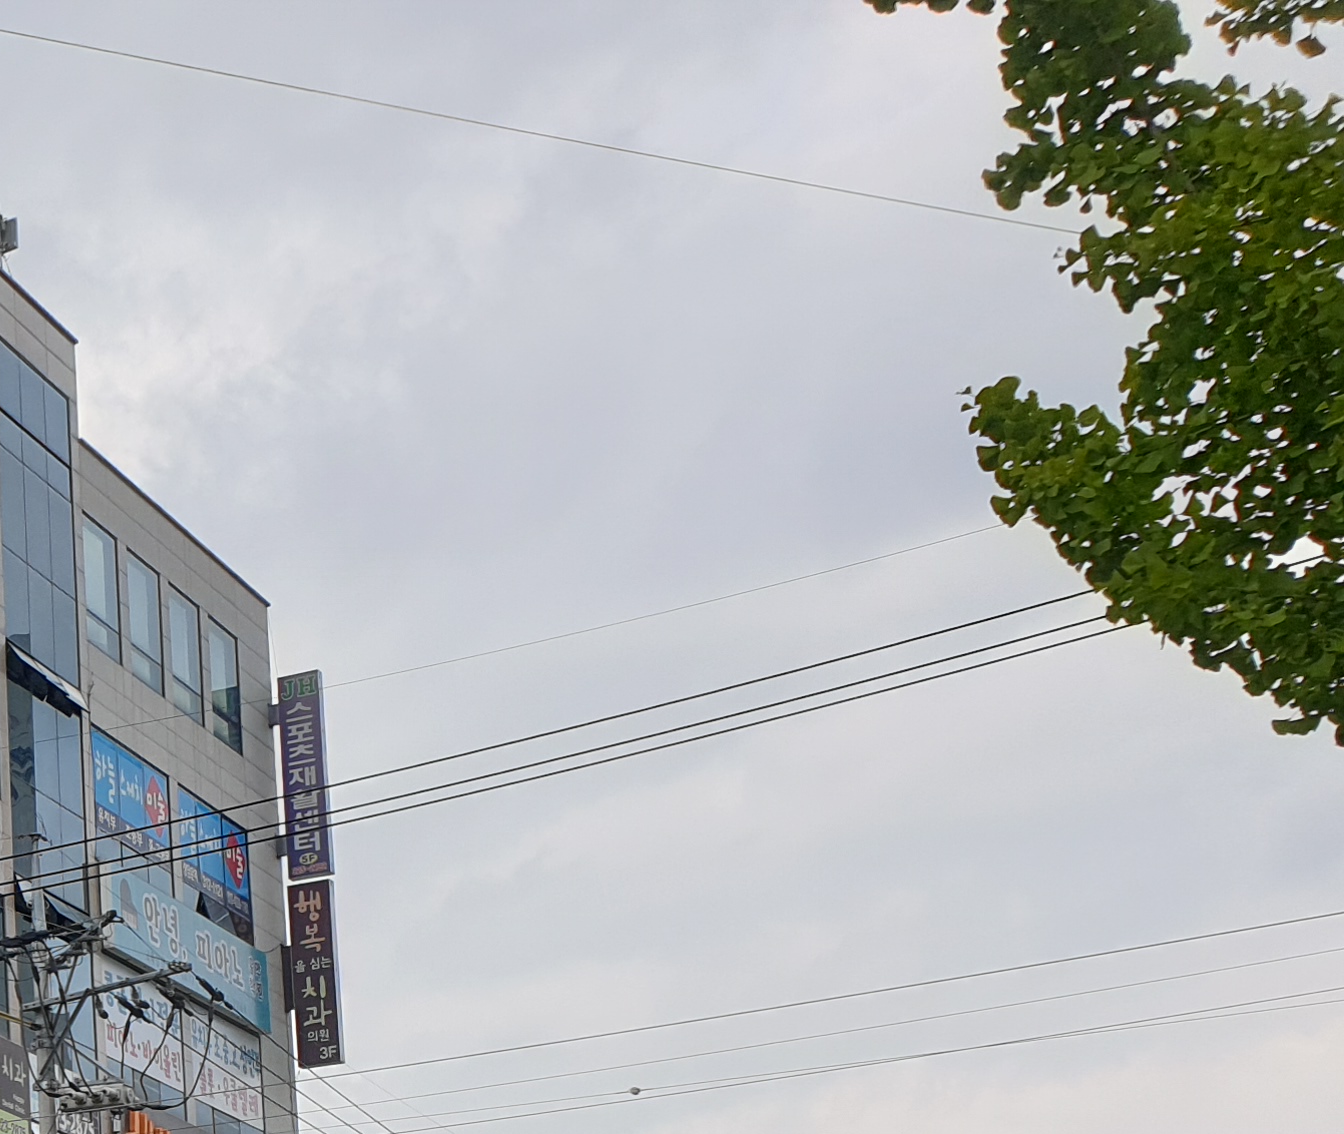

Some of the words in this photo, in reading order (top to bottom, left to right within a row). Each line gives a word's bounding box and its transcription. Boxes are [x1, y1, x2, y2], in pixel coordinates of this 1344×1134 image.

[280, 672, 318, 700] JH
[286, 700, 323, 852] 스포츠재활센터
[195, 930, 244, 989] 피아노
[307, 1028, 330, 1043] 의원
[319, 1045, 338, 1060] 3F
[2, 1055, 26, 1086] 치과
